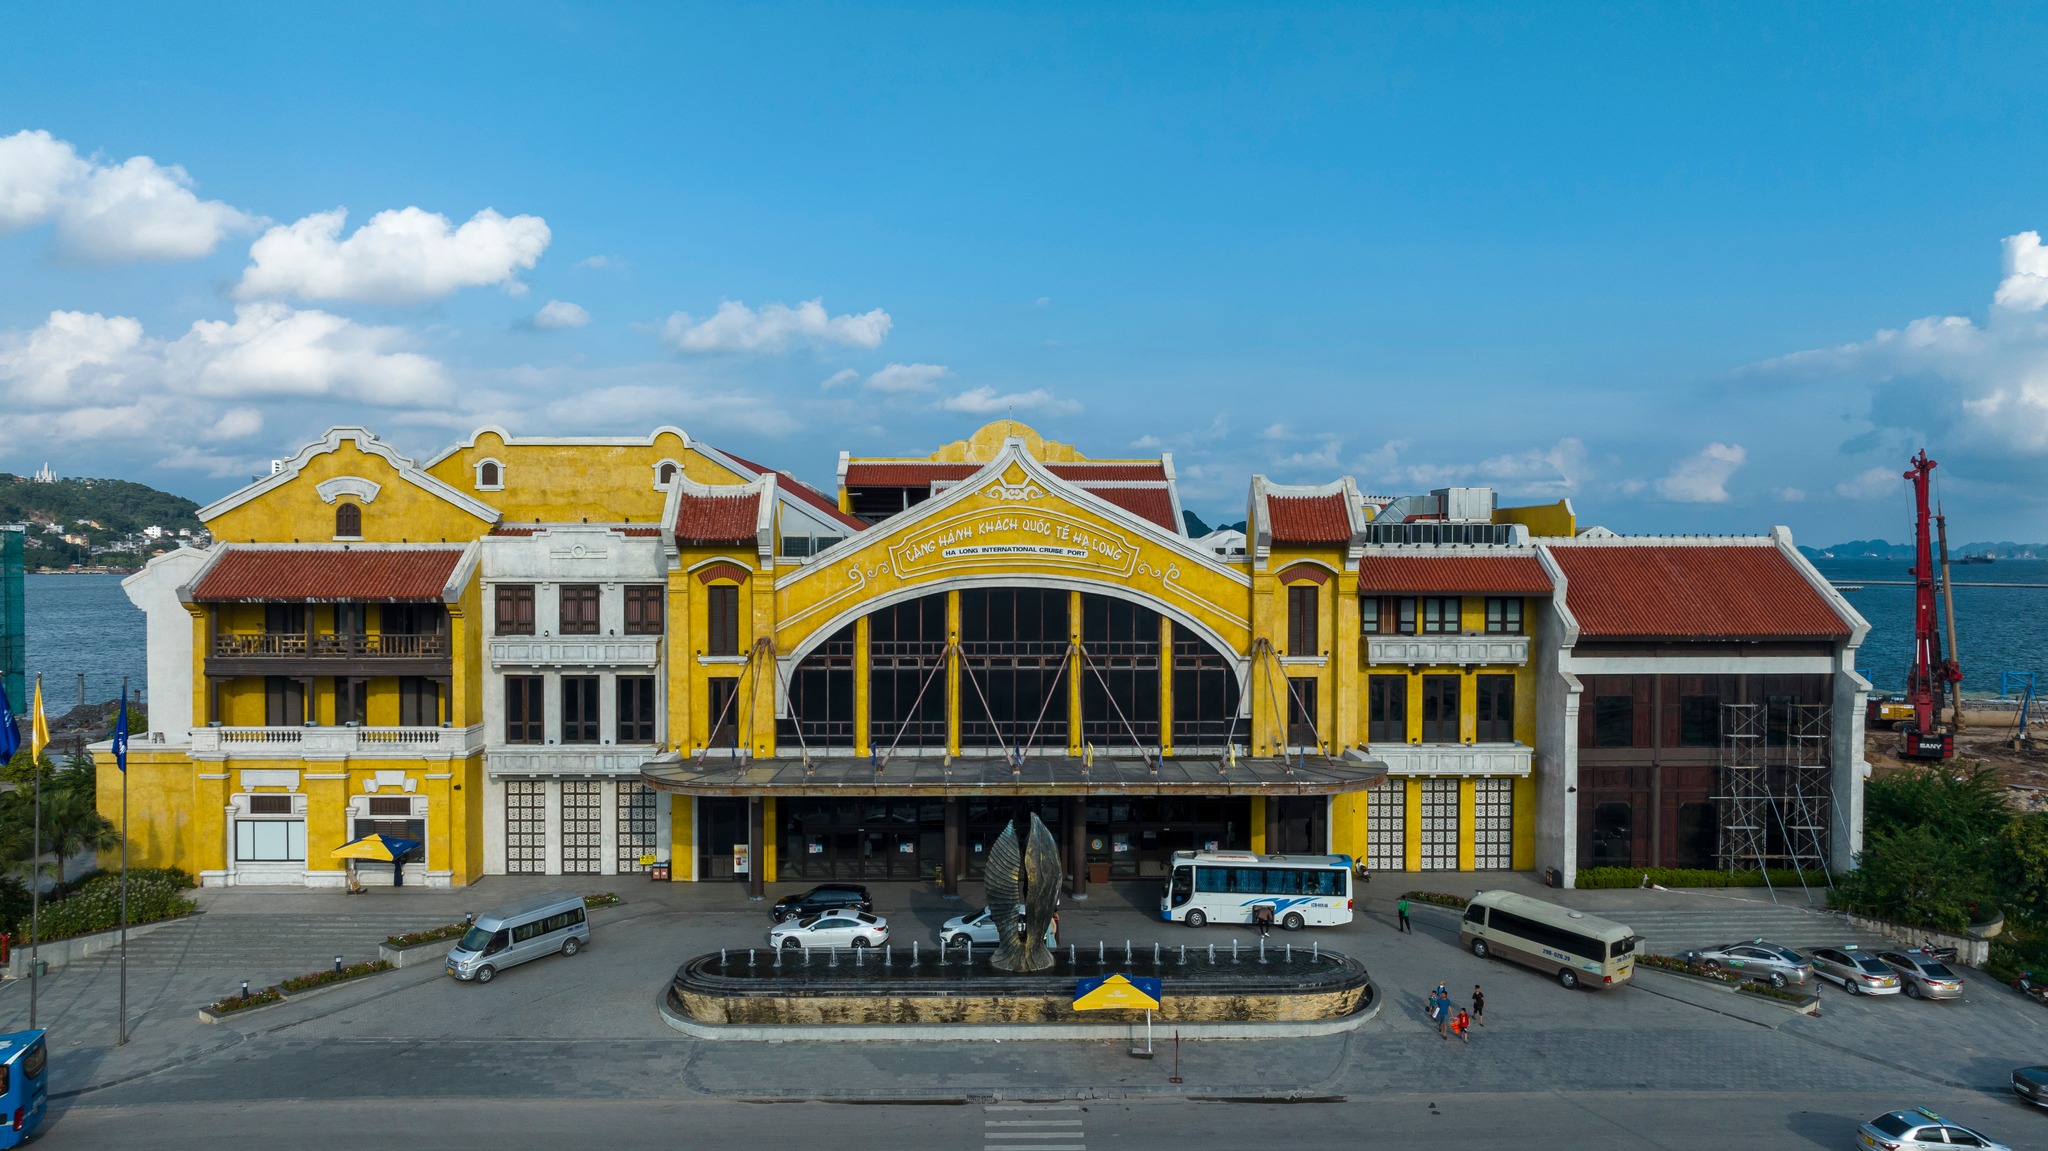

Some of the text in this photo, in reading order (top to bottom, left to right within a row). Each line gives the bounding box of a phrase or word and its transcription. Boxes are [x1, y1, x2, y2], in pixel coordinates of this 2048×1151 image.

[938, 526, 973, 546] HÀNH
[978, 516, 1018, 535] KHÁCH
[1022, 518, 1051, 535] QUỐC
[1056, 524, 1070, 540] TẾ
[1073, 532, 1090, 550] HẠ
[1092, 538, 1123, 560] LONG
[1039, 547, 1064, 555] CRUISE
